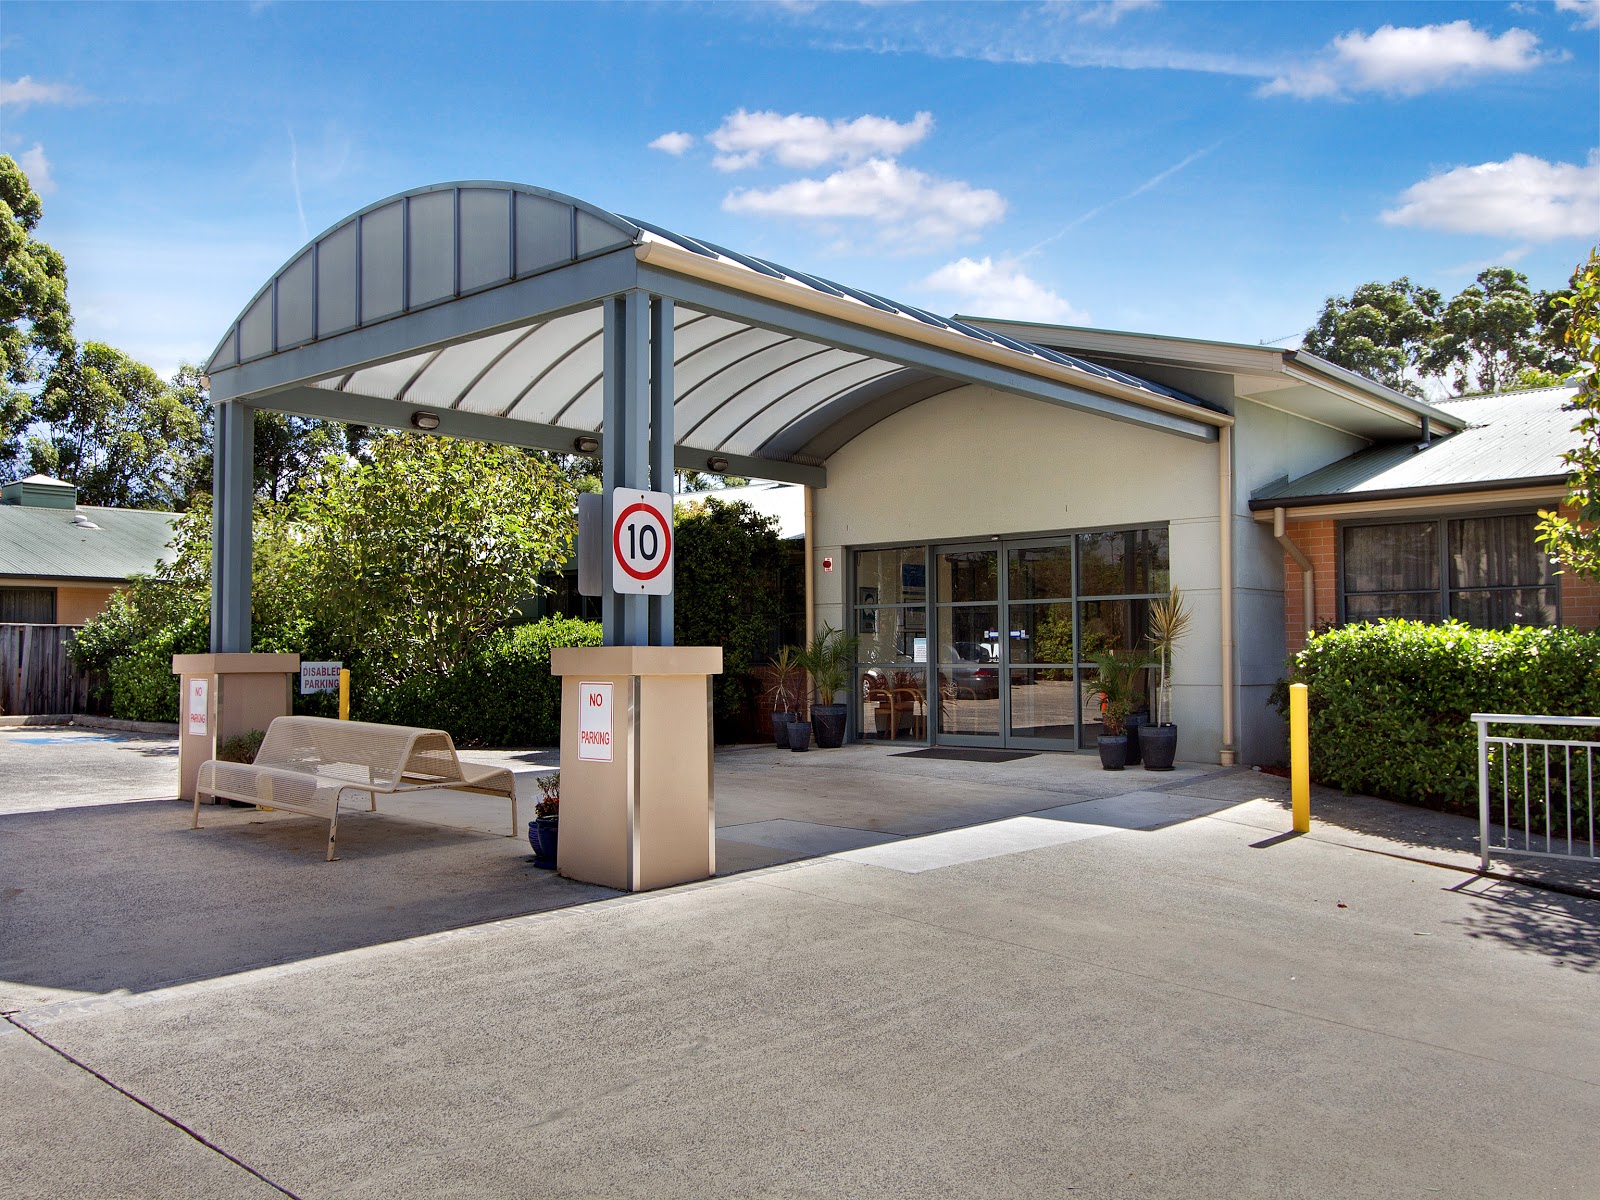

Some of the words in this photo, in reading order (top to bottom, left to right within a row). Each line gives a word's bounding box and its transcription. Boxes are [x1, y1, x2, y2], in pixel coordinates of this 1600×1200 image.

[627, 523, 658, 561] 10
[303, 667, 341, 677] DISABLED
[304, 679, 340, 689] PARKING
[195, 687, 203, 697] NO
[589, 693, 603, 707] NO
[581, 730, 610, 745] PARKING
